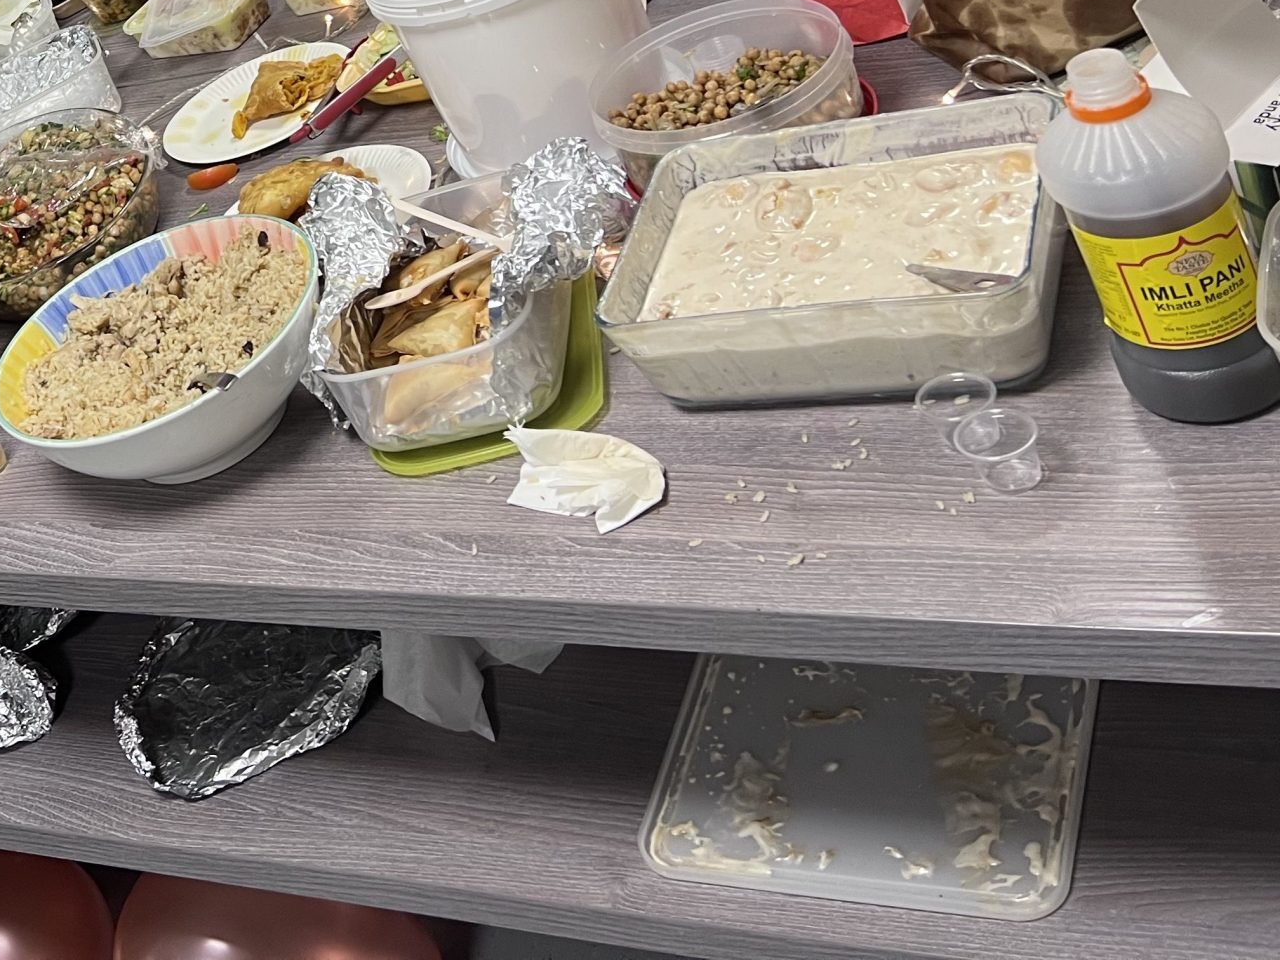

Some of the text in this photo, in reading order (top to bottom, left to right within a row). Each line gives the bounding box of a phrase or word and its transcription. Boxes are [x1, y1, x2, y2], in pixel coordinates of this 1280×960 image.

[1253, 100, 1280, 124] anda
[1140, 283, 1194, 302] IMLI
[1199, 255, 1245, 292] PANI
[1155, 299, 1202, 312] Khatta
[1204, 278, 1245, 304] Meetha
